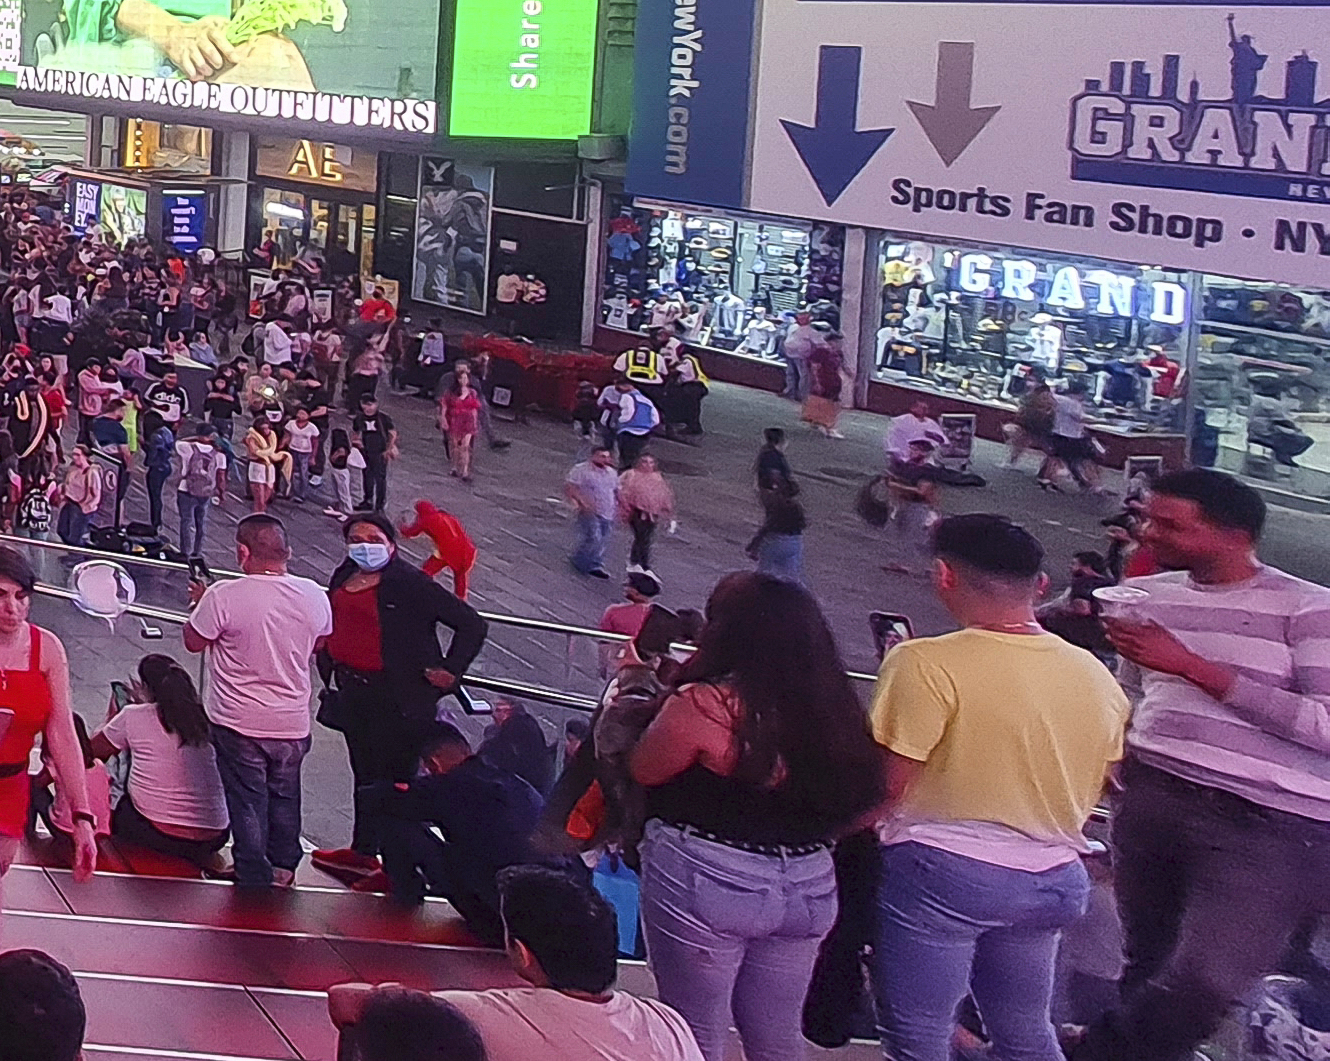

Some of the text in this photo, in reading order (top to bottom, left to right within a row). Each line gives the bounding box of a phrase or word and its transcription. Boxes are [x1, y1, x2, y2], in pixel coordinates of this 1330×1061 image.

[20, 67, 435, 132] AMERICAN EAGLE OUTFITTERS
[1073, 93, 1330, 174] GRAN
[76, 181, 100, 200] EASY
[288, 139, 344, 182] AE
[890, 178, 1011, 219] Sports
[1024, 192, 1095, 229] Fan
[1108, 201, 1224, 249] Shop
[959, 252, 1187, 325] GRAND
